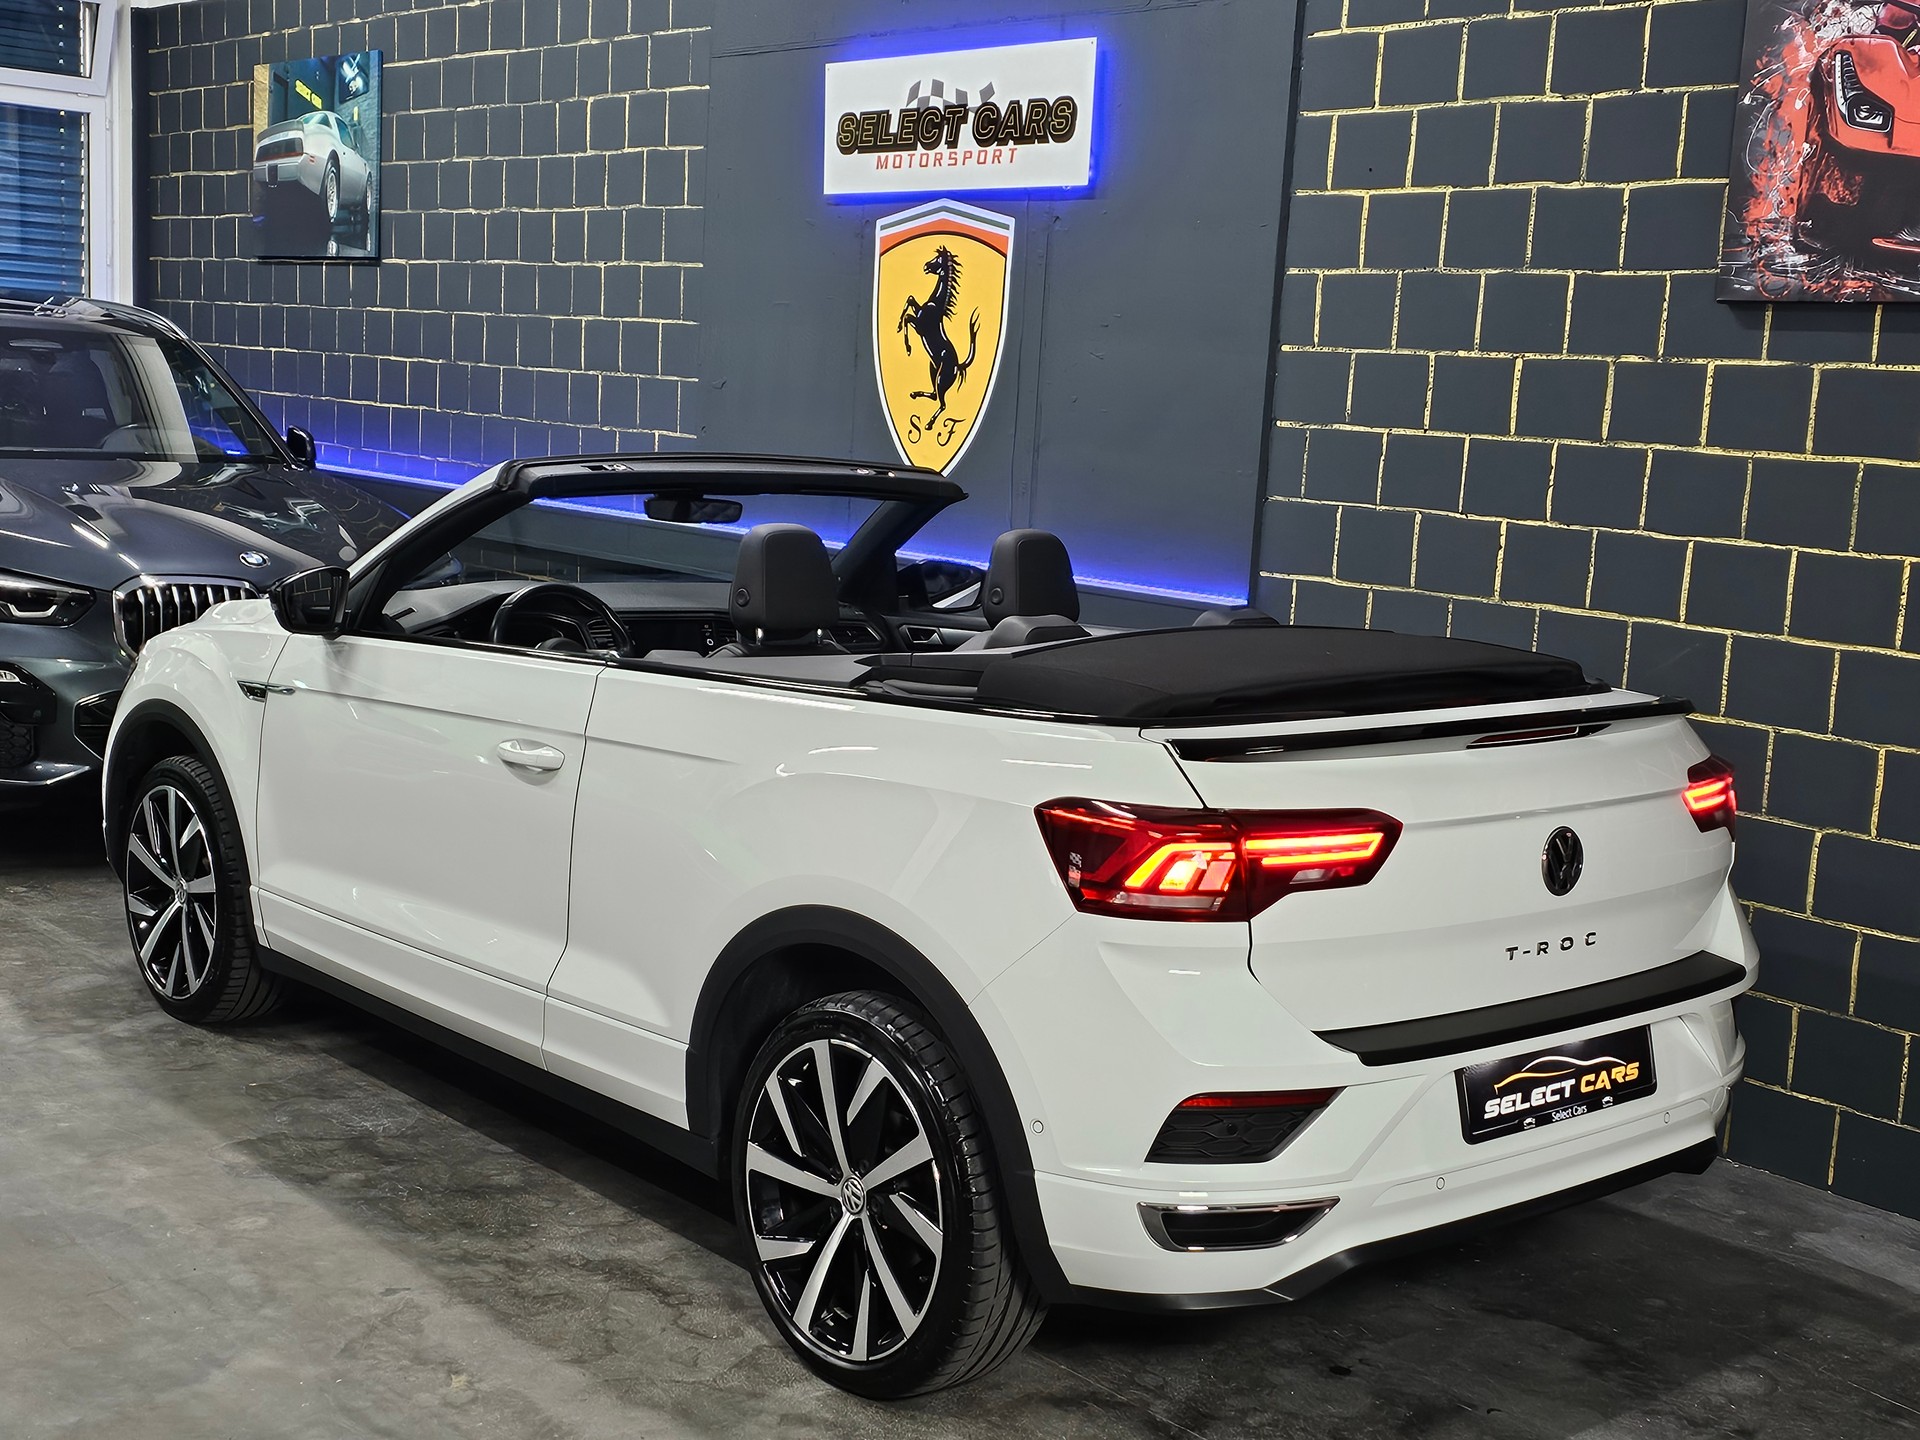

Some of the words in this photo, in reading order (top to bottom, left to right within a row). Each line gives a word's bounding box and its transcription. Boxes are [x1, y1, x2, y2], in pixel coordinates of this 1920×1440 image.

[836, 105, 968, 155] SELECT
[972, 95, 1078, 147] CARS
[876, 147, 1018, 170] MOTORSPORT
[907, 414, 922, 444] S
[1505, 931, 1597, 961] T-ROC
[1483, 1079, 1576, 1120] SELECT
[1580, 1061, 1640, 1094] CARS
[1551, 1107, 1573, 1122] Select
[1573, 1104, 1588, 1116] Cars
